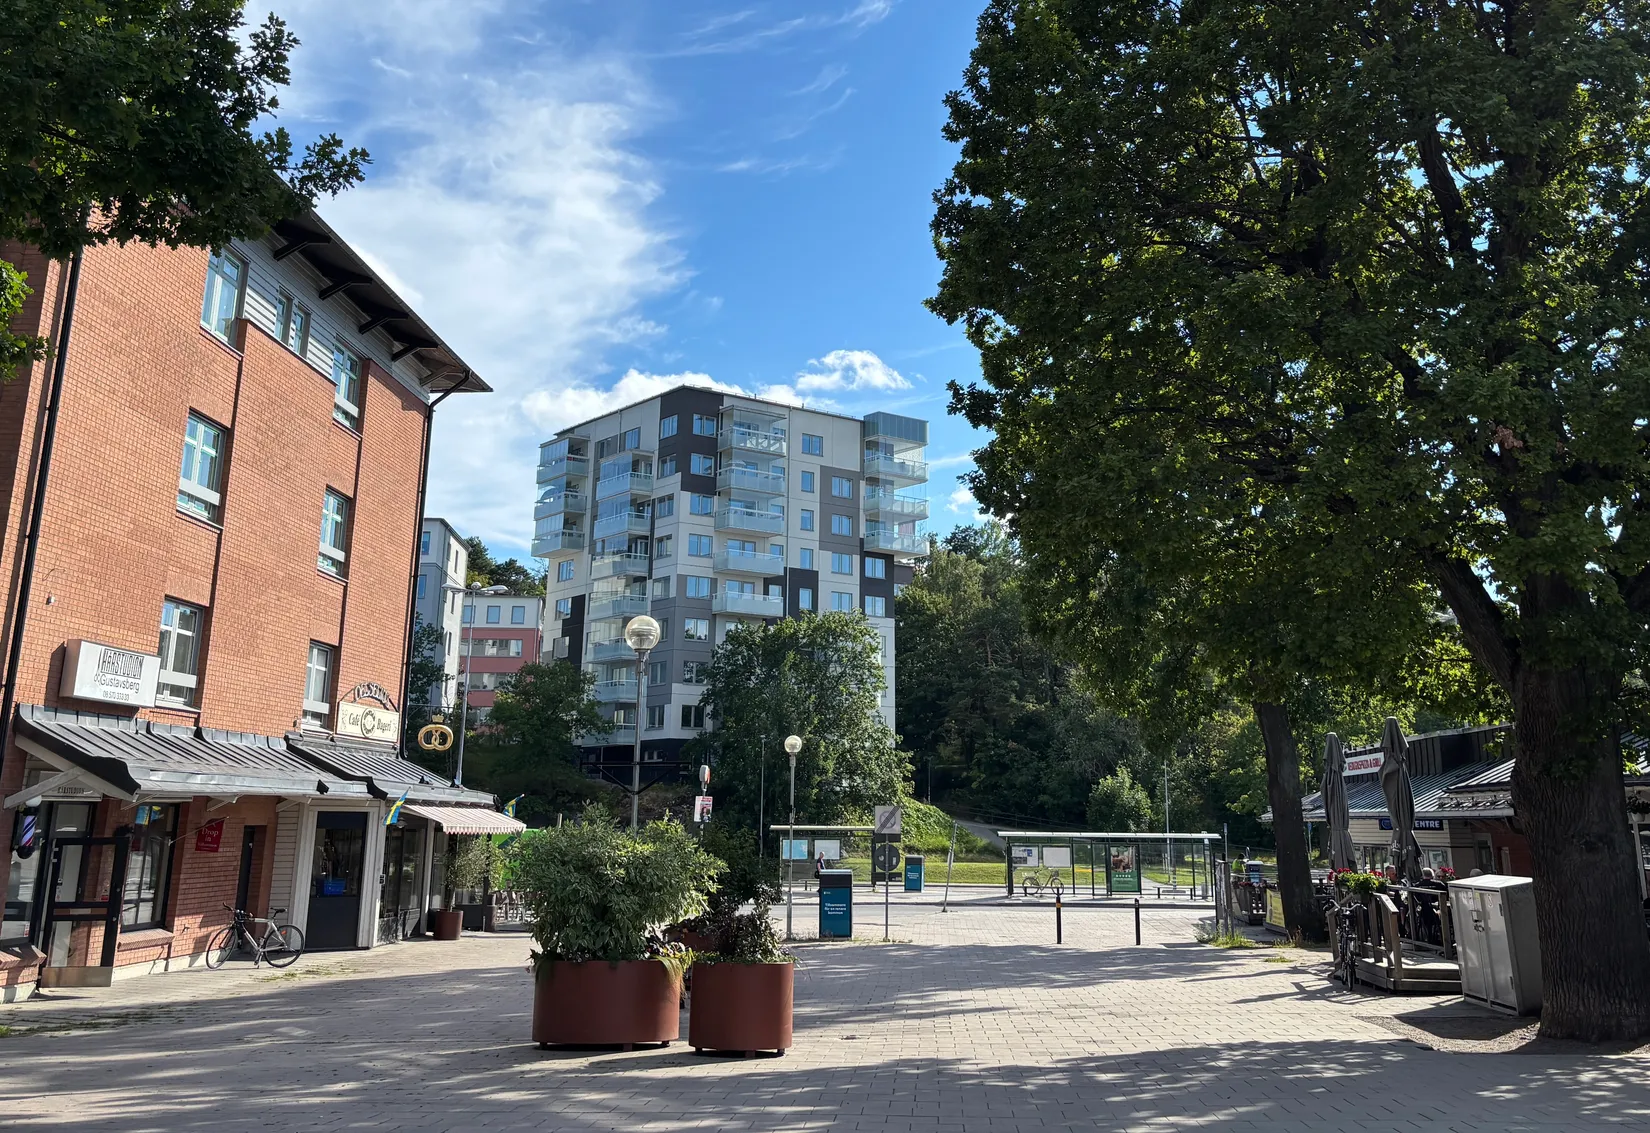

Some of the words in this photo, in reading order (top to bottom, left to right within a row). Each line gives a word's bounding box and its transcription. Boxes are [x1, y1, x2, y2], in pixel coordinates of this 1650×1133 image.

[102, 650, 143, 677] HÅRSTUDION
[100, 674, 139, 693] Gustavsberg
[349, 713, 360, 726] Café
[376, 718, 392, 733] Bageri
[202, 828, 218, 837] Drop
